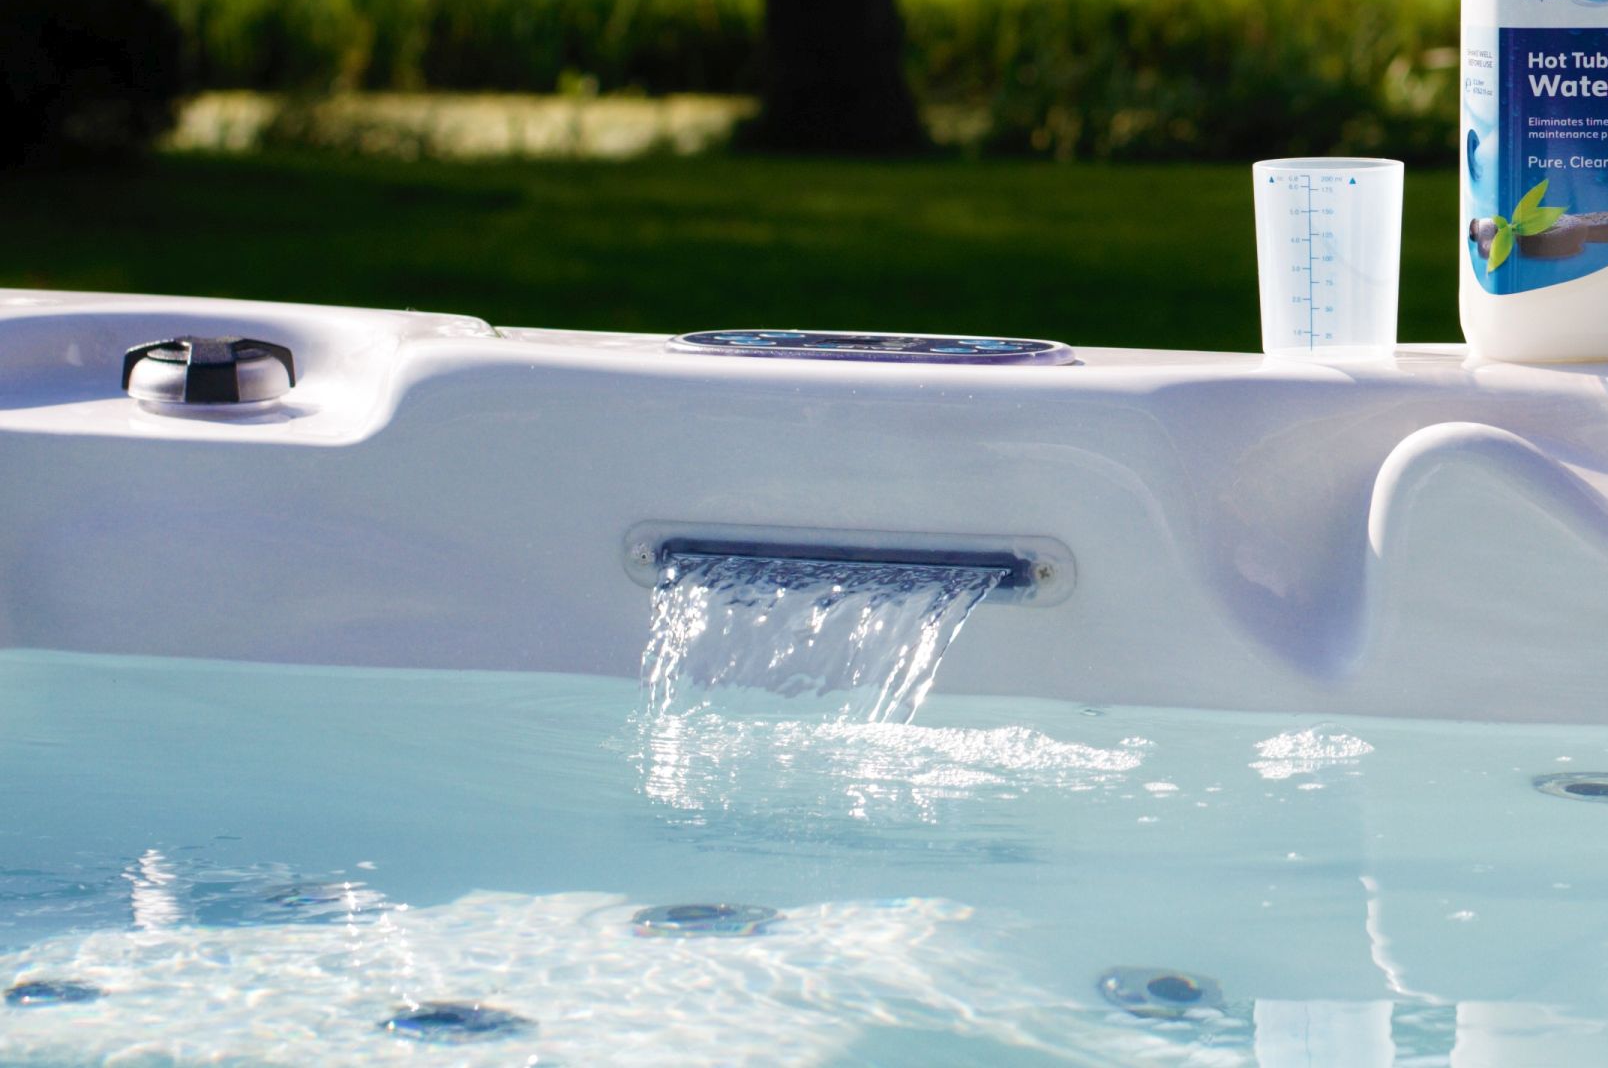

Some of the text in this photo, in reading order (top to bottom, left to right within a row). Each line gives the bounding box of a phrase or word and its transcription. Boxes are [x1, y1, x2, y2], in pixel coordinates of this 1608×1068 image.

[1528, 52, 1567, 69] Hot
[1571, 52, 1608, 69] Tub
[1528, 116, 1583, 127] Eliminates
[1586, 116, 1608, 127] time
[1528, 130, 1599, 139] maintenance
[1528, 156, 1567, 170] Pure,
